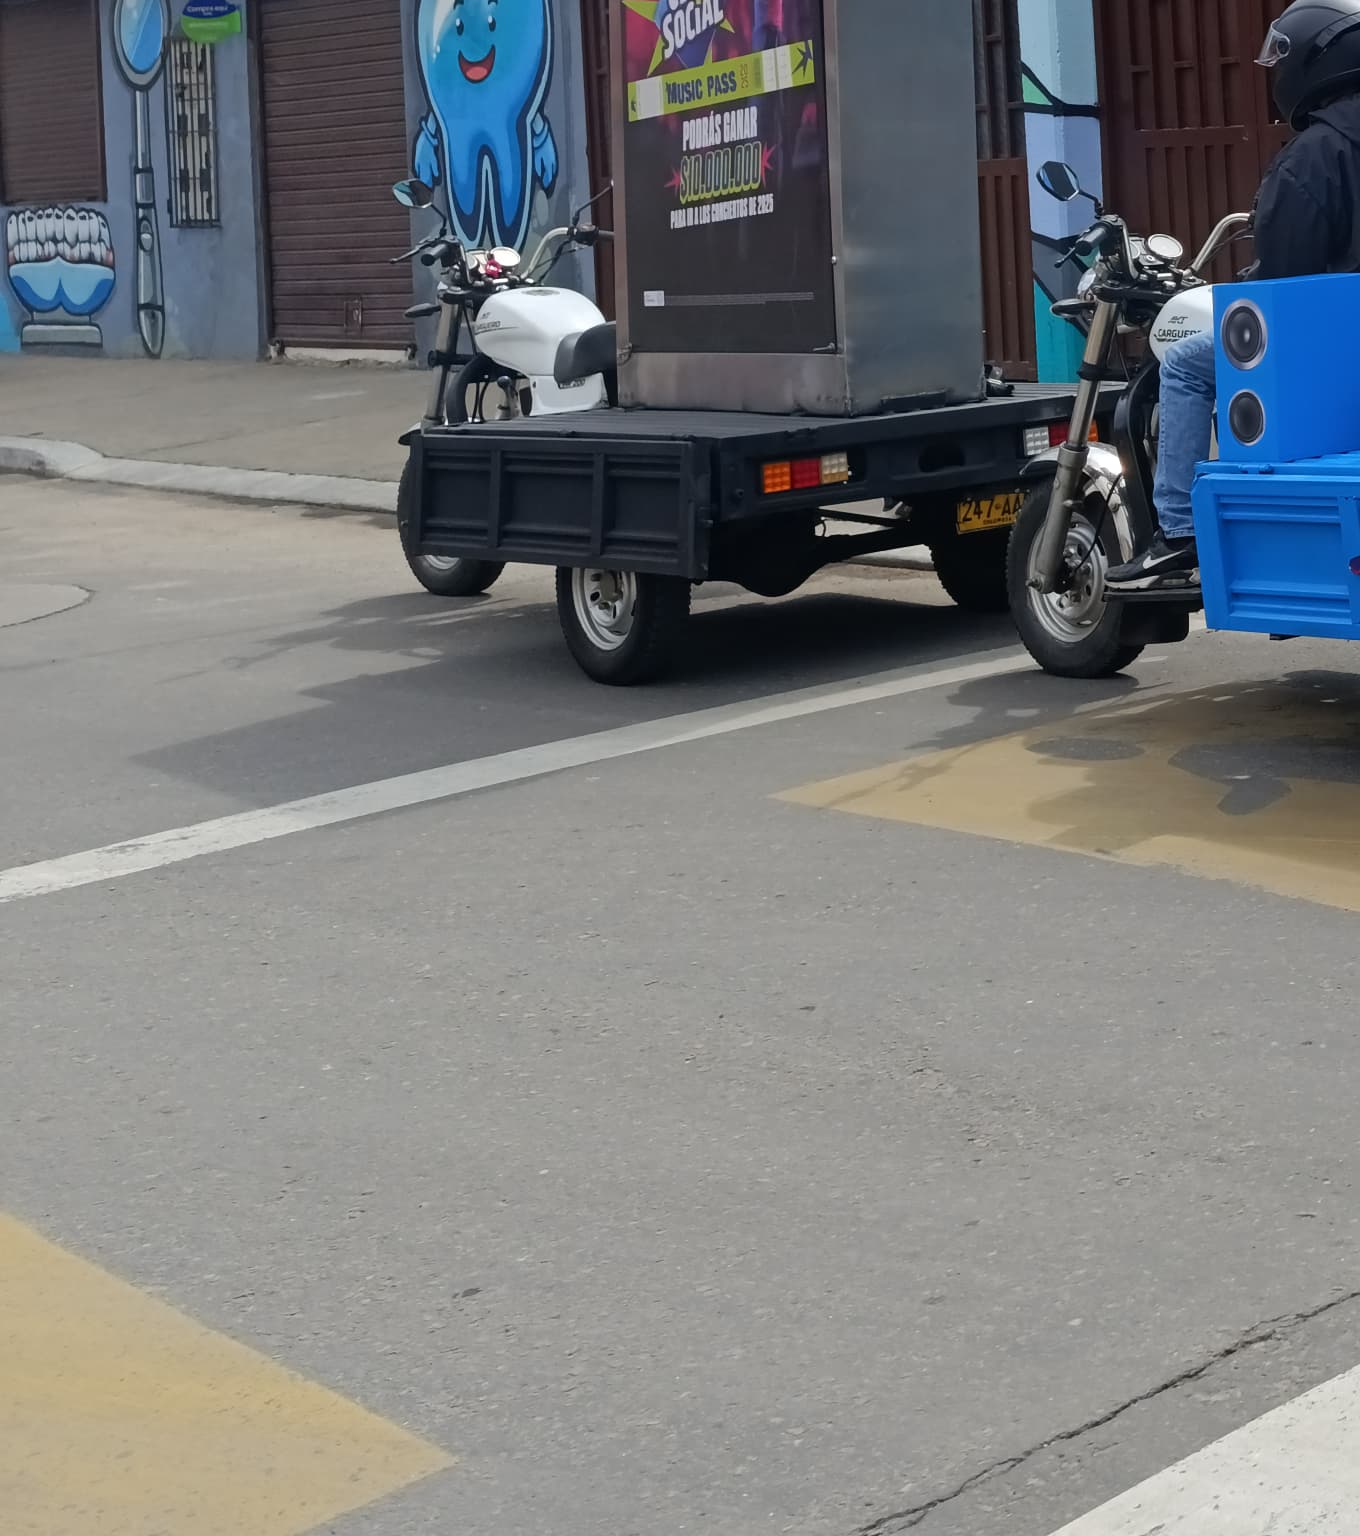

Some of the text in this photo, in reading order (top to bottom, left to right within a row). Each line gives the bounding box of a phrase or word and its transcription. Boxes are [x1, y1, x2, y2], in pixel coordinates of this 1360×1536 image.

[666, 70, 737, 105] MUSIC PASS
[682, 105, 758, 152] PODRÁS GANAR
[680, 141, 761, 204] $10.000.000
[671, 208, 686, 229] PARA
[699, 203, 711, 224] LOS
[711, 197, 748, 222] CONCIERTOS
[748, 196, 757, 216] DE
[757, 192, 774, 213] 2025
[962, 493, 1023, 523] 247 AA
